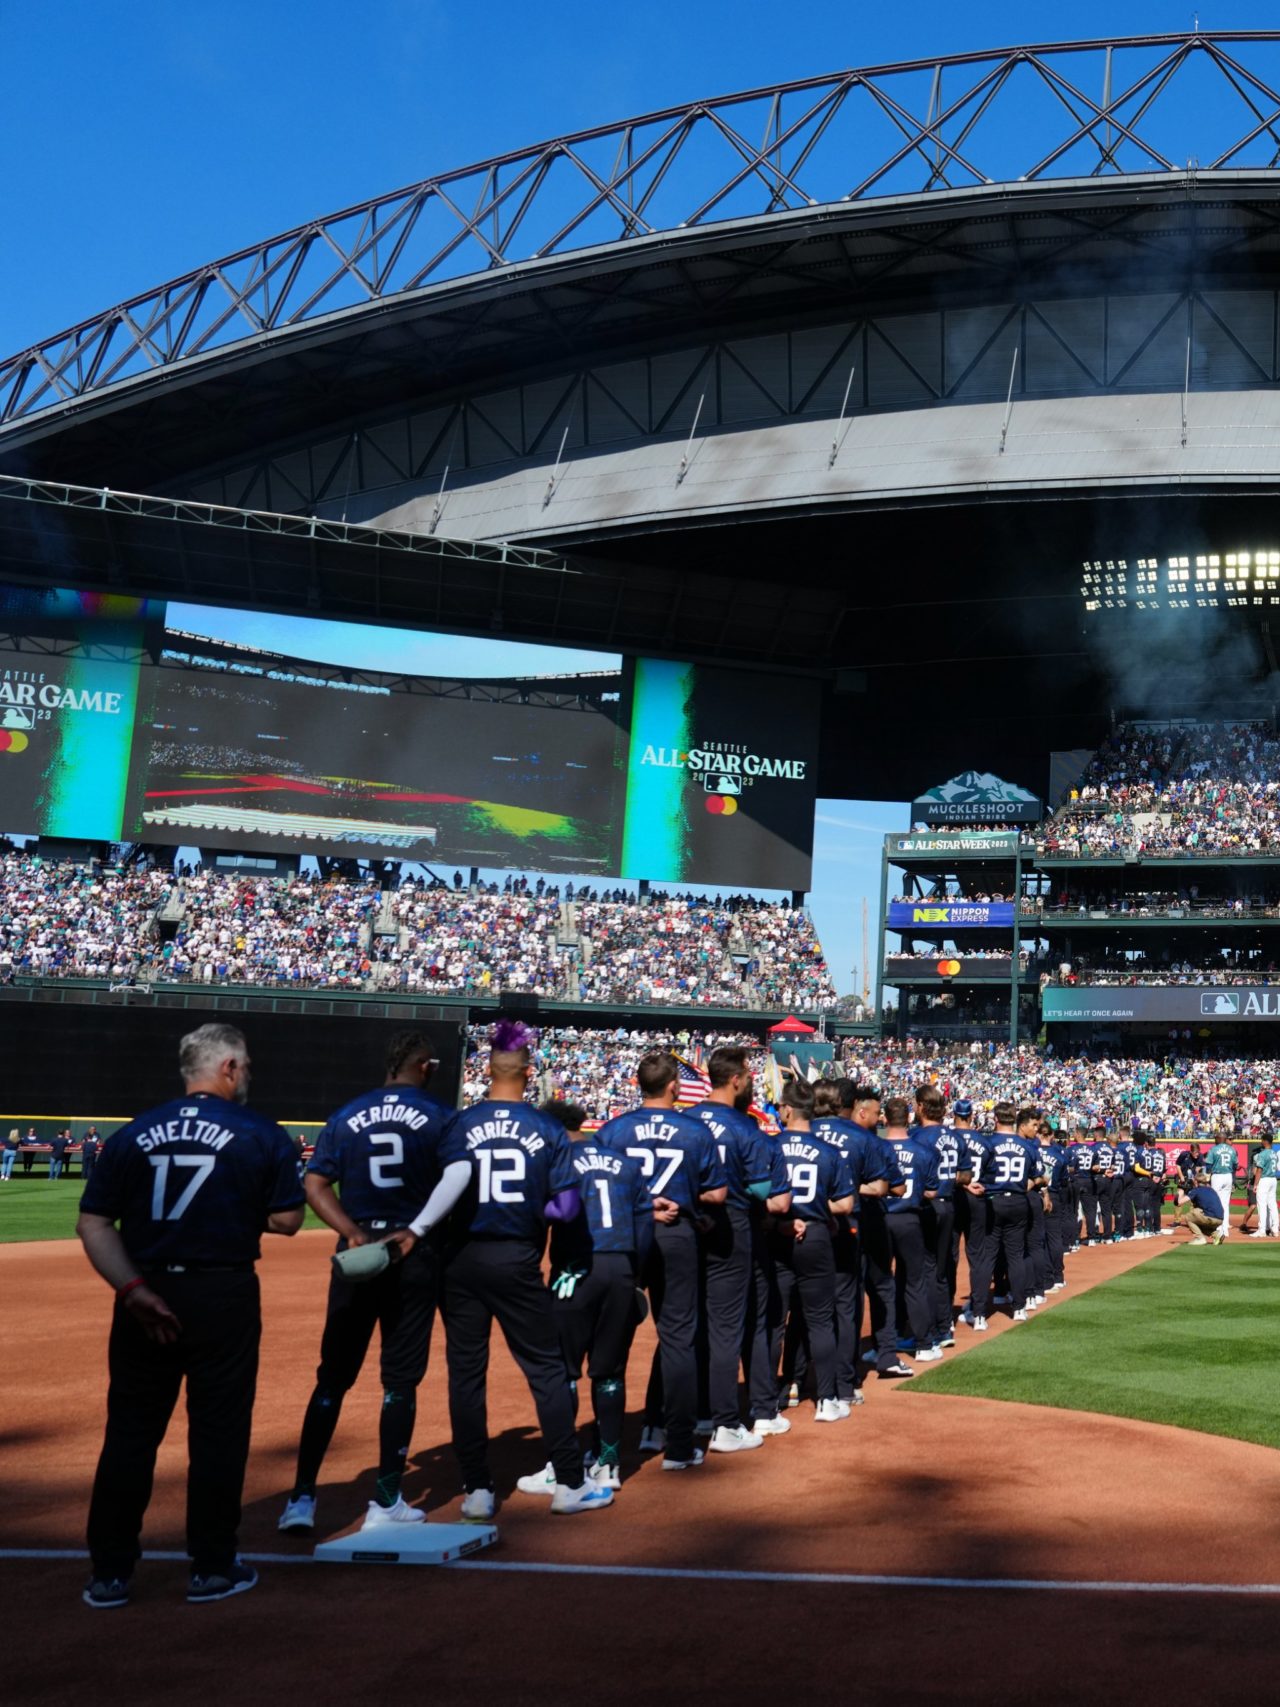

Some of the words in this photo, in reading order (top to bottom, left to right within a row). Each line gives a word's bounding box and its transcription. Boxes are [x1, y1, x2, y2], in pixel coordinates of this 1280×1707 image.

[3, 669, 45, 683] ATTLE
[0, 681, 36, 705] AR
[39, 684, 121, 714] GAME
[37, 709, 52, 720] 23
[703, 741, 748, 754] SEATTLE
[692, 772, 704, 782] 20
[743, 755, 806, 779] GAME
[742, 776, 754, 786] 23
[928, 803, 1024, 815] MUCKLESHOOT
[961, 838, 990, 849] WEEK
[991, 840, 1008, 848] 2023
[347, 1104, 429, 1134] PERDOMO
[136, 1119, 235, 1153] SHELTON
[466, 1119, 520, 1150] URRIEL
[519, 1131, 545, 1158] JR.
[634, 1123, 680, 1143] RILEY
[368, 1132, 404, 1188] 2
[781, 1143, 820, 1162] RIDER
[994, 1142, 1026, 1156] BURNES
[1129, 1152, 1135, 1166] 5
[1220, 1153, 1231, 1167] 12
[573, 1153, 623, 1175] ALBIES
[937, 1149, 959, 1180] 22
[994, 1156, 1026, 1183] 39
[474, 1148, 526, 1204] 12
[786, 1163, 818, 1204] 9
[148, 1154, 217, 1221] 17
[594, 1179, 613, 1229] 1
